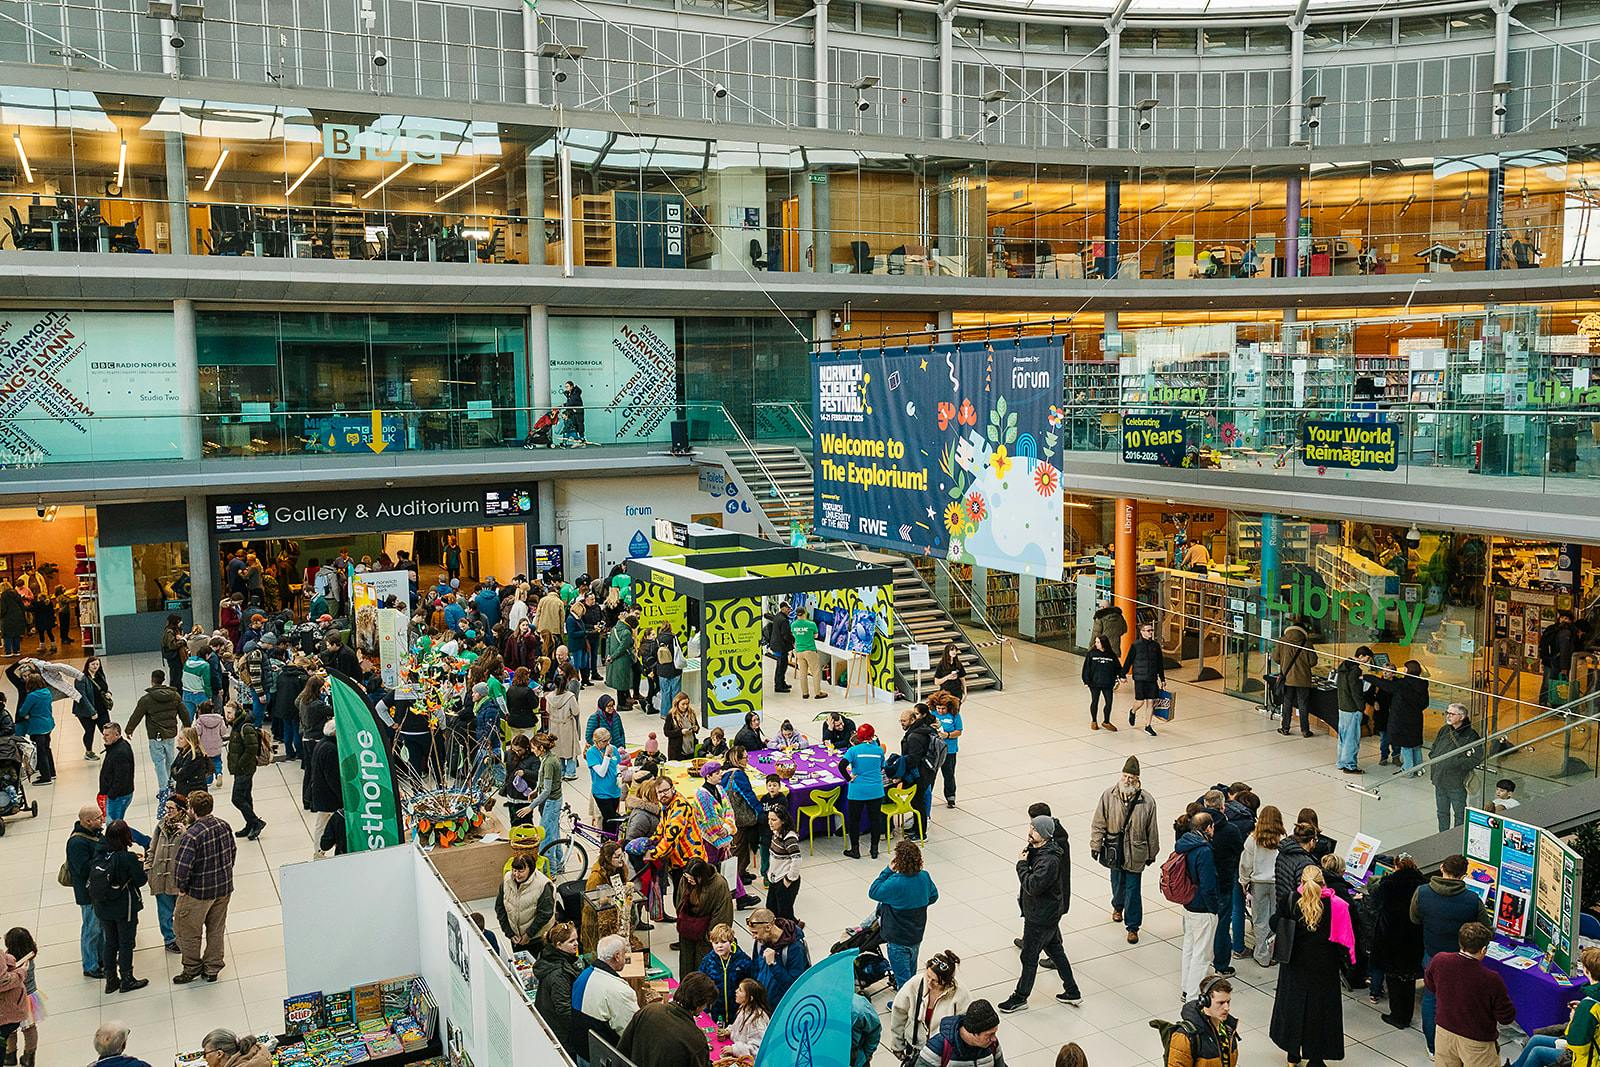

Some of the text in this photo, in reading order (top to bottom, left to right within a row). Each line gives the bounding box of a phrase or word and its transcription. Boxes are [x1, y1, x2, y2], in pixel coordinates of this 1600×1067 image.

[667, 205, 681, 254] BBC
[31, 313, 71, 353] MARKET
[32, 328, 75, 368] LYNN
[45, 346, 73, 371] STALHAM
[51, 341, 88, 376] HETHERSETT
[612, 338, 652, 378] FAKENHAM
[620, 324, 674, 378] NORWICH
[623, 340, 663, 378] HUNSTANTON
[820, 364, 862, 381] NORWICH
[1012, 367, 1050, 389] forum
[37, 370, 95, 417] DEREHAM
[39, 383, 77, 417] HEACHAM
[140, 394, 180, 402] Studio Two
[605, 370, 642, 414] THETFORD
[622, 375, 659, 418] CROMER
[820, 381, 857, 396] SCIENCE
[1148, 385, 1209, 405] Library
[820, 397, 863, 413] FESTIVAL
[1125, 417, 1160, 429] Celebrating
[820, 432, 905, 459] Welcome to
[1125, 429, 1183, 448] 10 Years
[1308, 426, 1395, 447] Your World,
[1125, 450, 1158, 461] 2016-2026
[1306, 443, 1395, 467] Reimagined
[820, 459, 928, 491] The Explorium!
[275, 505, 348, 523] Gallery
[355, 504, 369, 518] &
[375, 498, 479, 518] Auditorium
[625, 505, 652, 516] forum
[1124, 504, 1134, 534] Library
[821, 518, 849, 530] OF THE ARTS
[859, 516, 888, 537] RWE
[1267, 568, 1425, 647] Library
[714, 631, 736, 646] UEA
